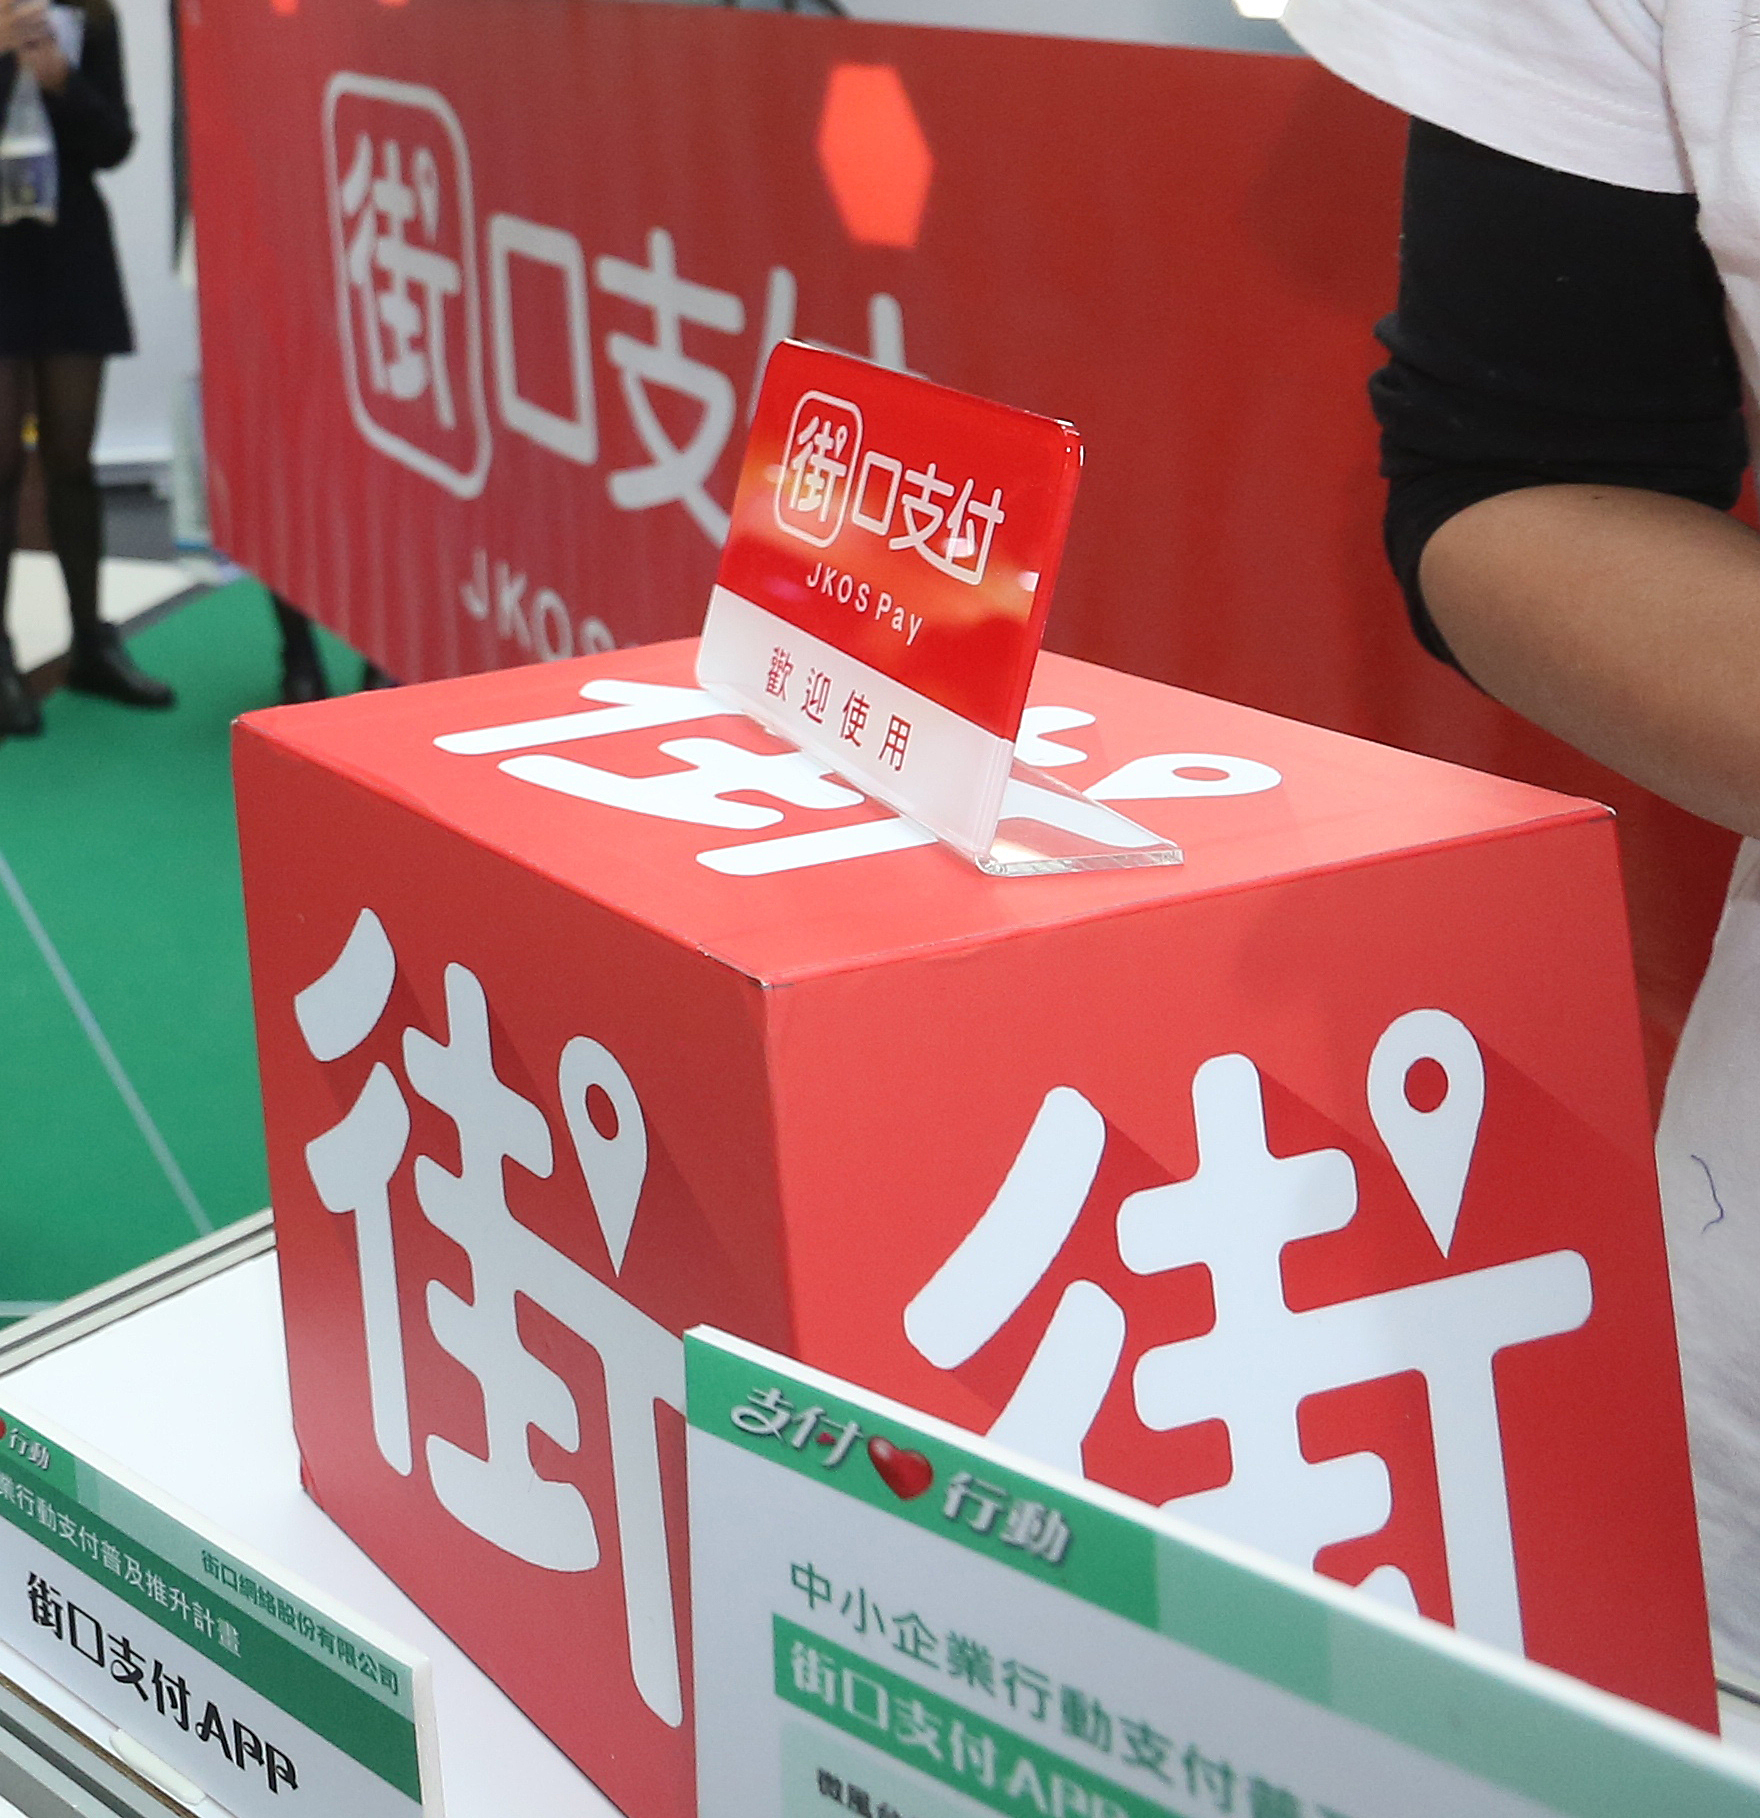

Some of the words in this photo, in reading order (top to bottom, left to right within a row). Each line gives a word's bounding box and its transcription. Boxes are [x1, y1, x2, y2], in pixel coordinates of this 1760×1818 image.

[787, 414, 1005, 586] 街口支付
[805, 561, 871, 613] JKOS
[874, 590, 924, 647] Pay
[764, 646, 913, 773] 歡迎使用
[294, 907, 686, 1729] 街
[902, 1006, 1594, 1660] 街
[728, 1384, 866, 1470] 支付
[940, 1471, 1072, 1567] 行動
